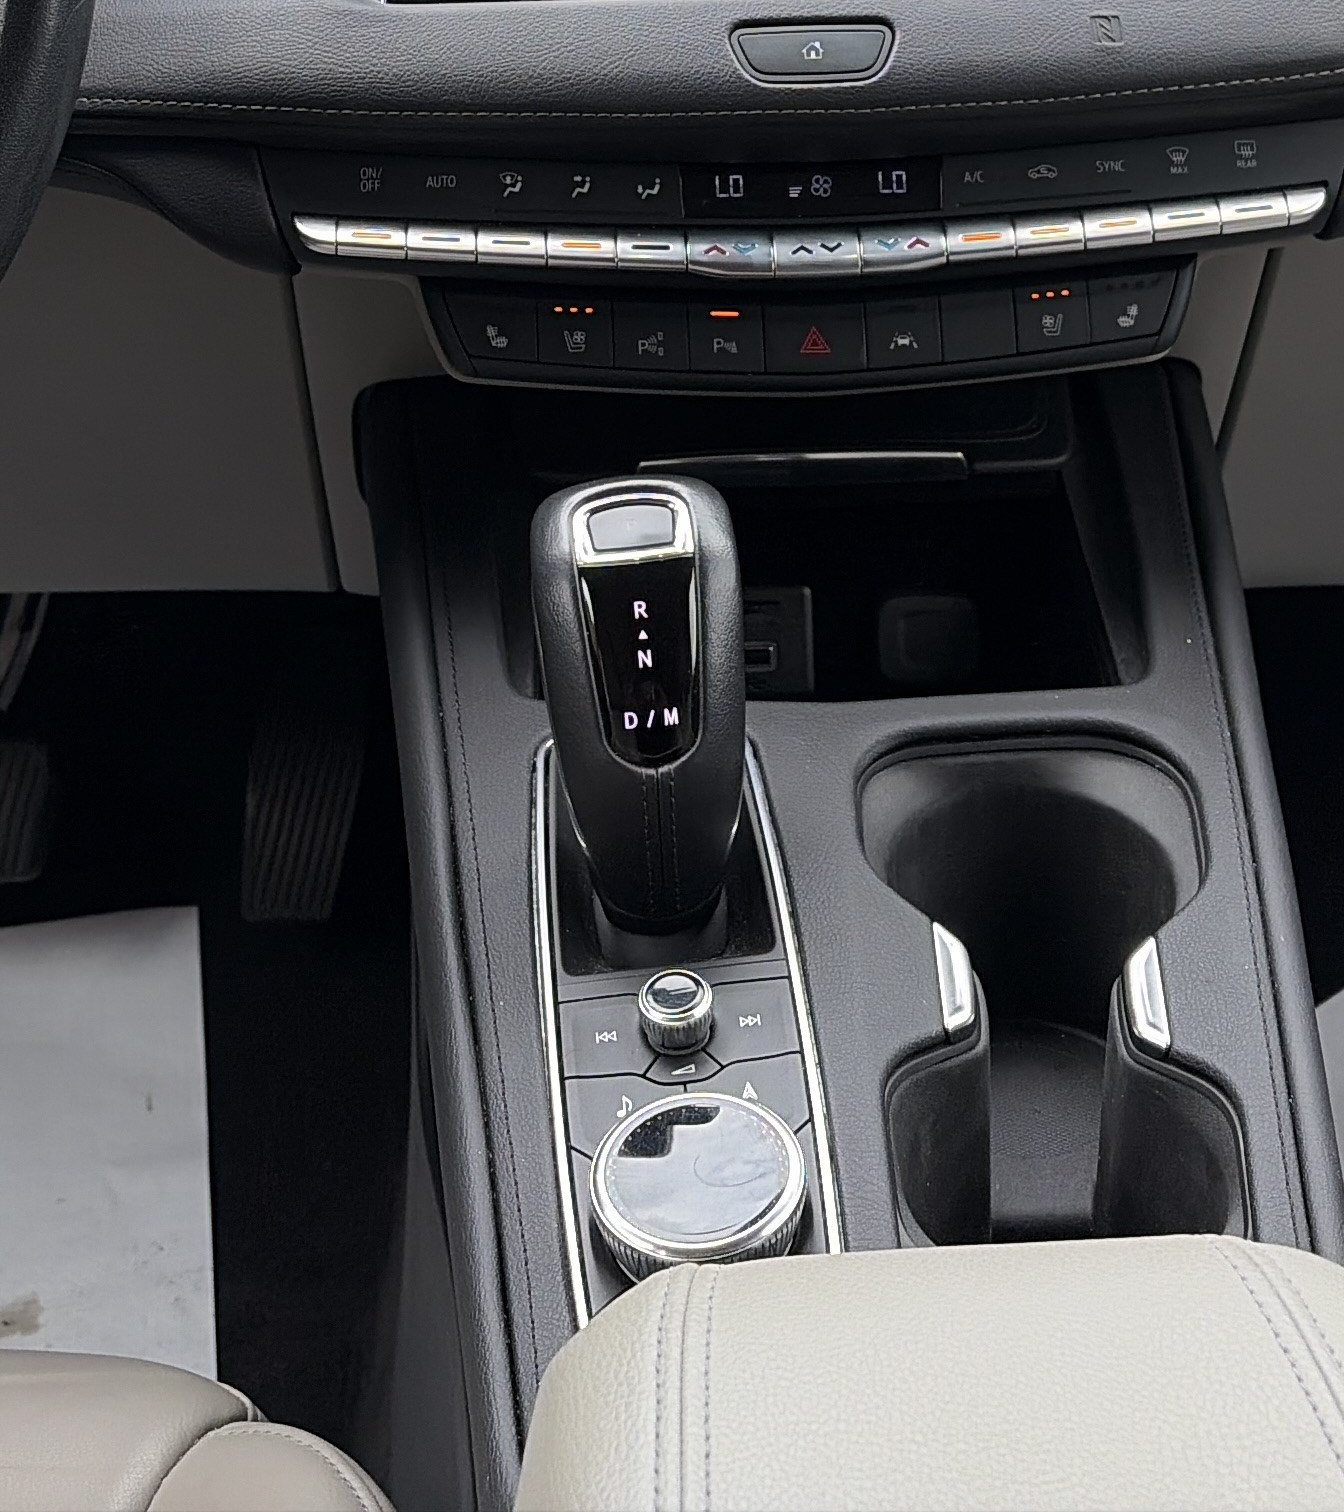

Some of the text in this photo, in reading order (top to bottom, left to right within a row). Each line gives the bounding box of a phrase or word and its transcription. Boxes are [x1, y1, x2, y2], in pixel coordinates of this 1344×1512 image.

[1095, 159, 1125, 173] SYNC
[1170, 166, 1188, 174] MAX
[1236, 159, 1257, 168] REAR
[360, 167, 382, 180] ON/
[964, 170, 985, 183] A/C
[360, 179, 381, 192] OFF
[426, 174, 456, 188] AUTO
[714, 174, 744, 198] LO
[878, 170, 906, 194] LO
[633, 600, 649, 620] R
[637, 649, 653, 669] N
